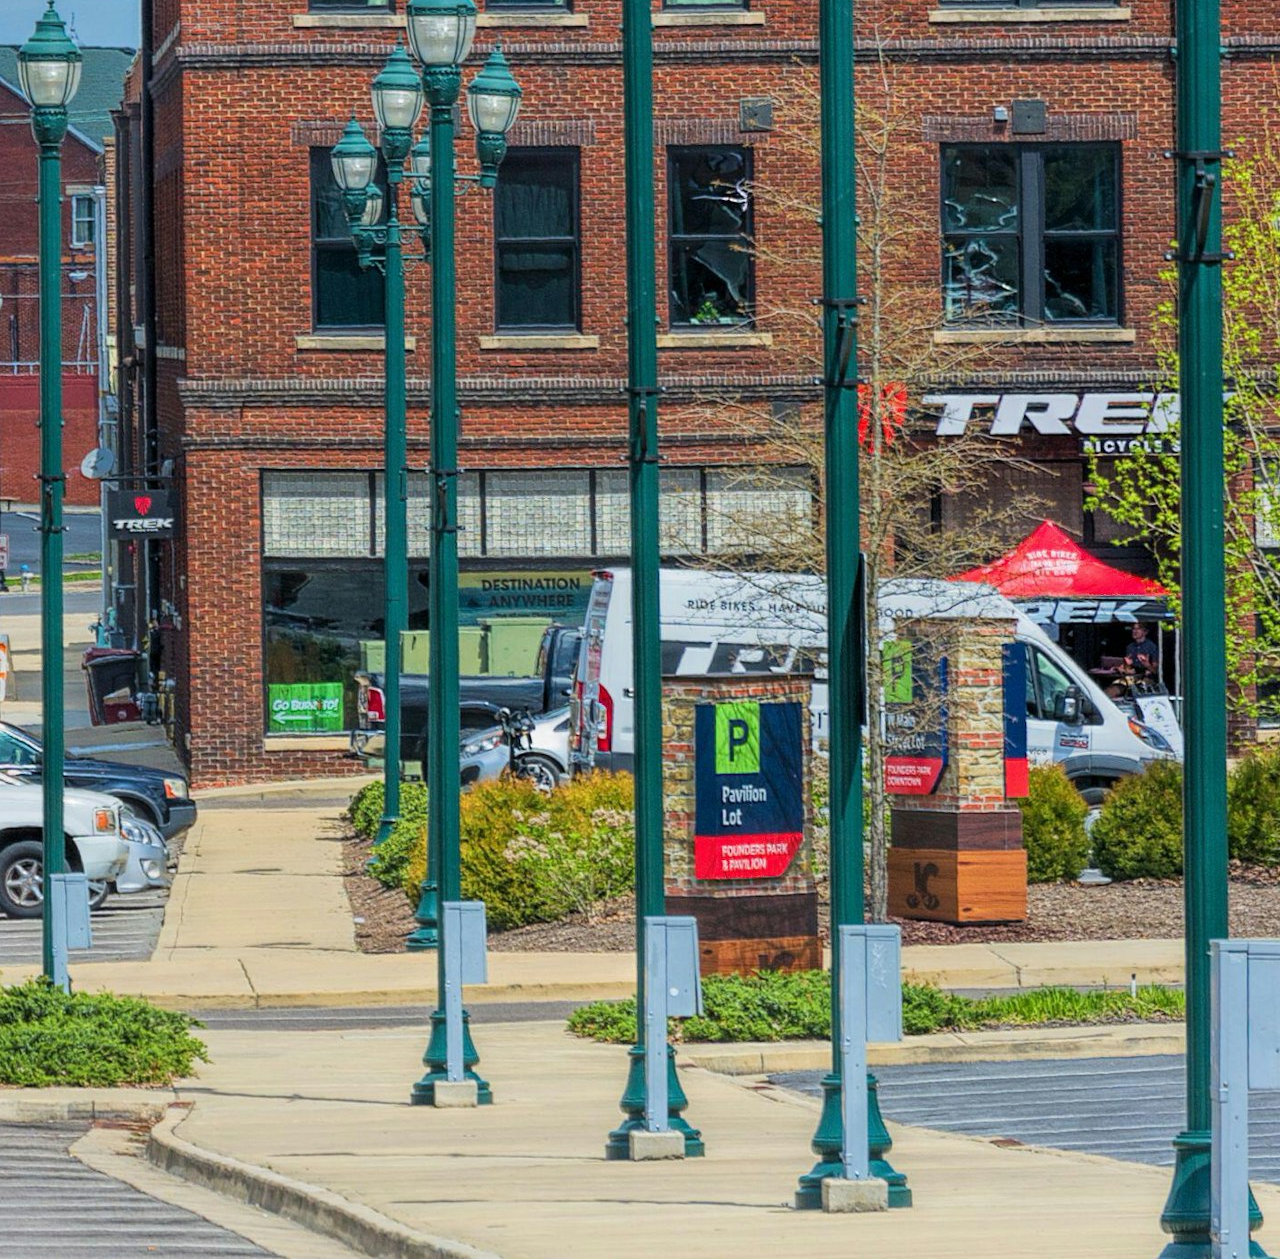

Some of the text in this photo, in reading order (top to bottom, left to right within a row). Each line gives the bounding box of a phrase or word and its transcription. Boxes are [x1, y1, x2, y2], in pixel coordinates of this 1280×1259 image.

[1084, 440, 1163, 453] BICYCLE
[113, 518, 174, 529] TREK
[482, 578, 580, 592] DESTINATION
[489, 594, 575, 608] ANYWHERE
[687, 600, 715, 610] RIDE
[720, 600, 755, 612] BIKES
[768, 603, 800, 614] HAVE
[729, 719, 749, 762] P
[722, 784, 767, 803] Pavilion
[722, 808, 742, 825] Lot
[722, 843, 788, 857] FOUNDERS PARK
[730, 858, 767, 870] PAVILION
